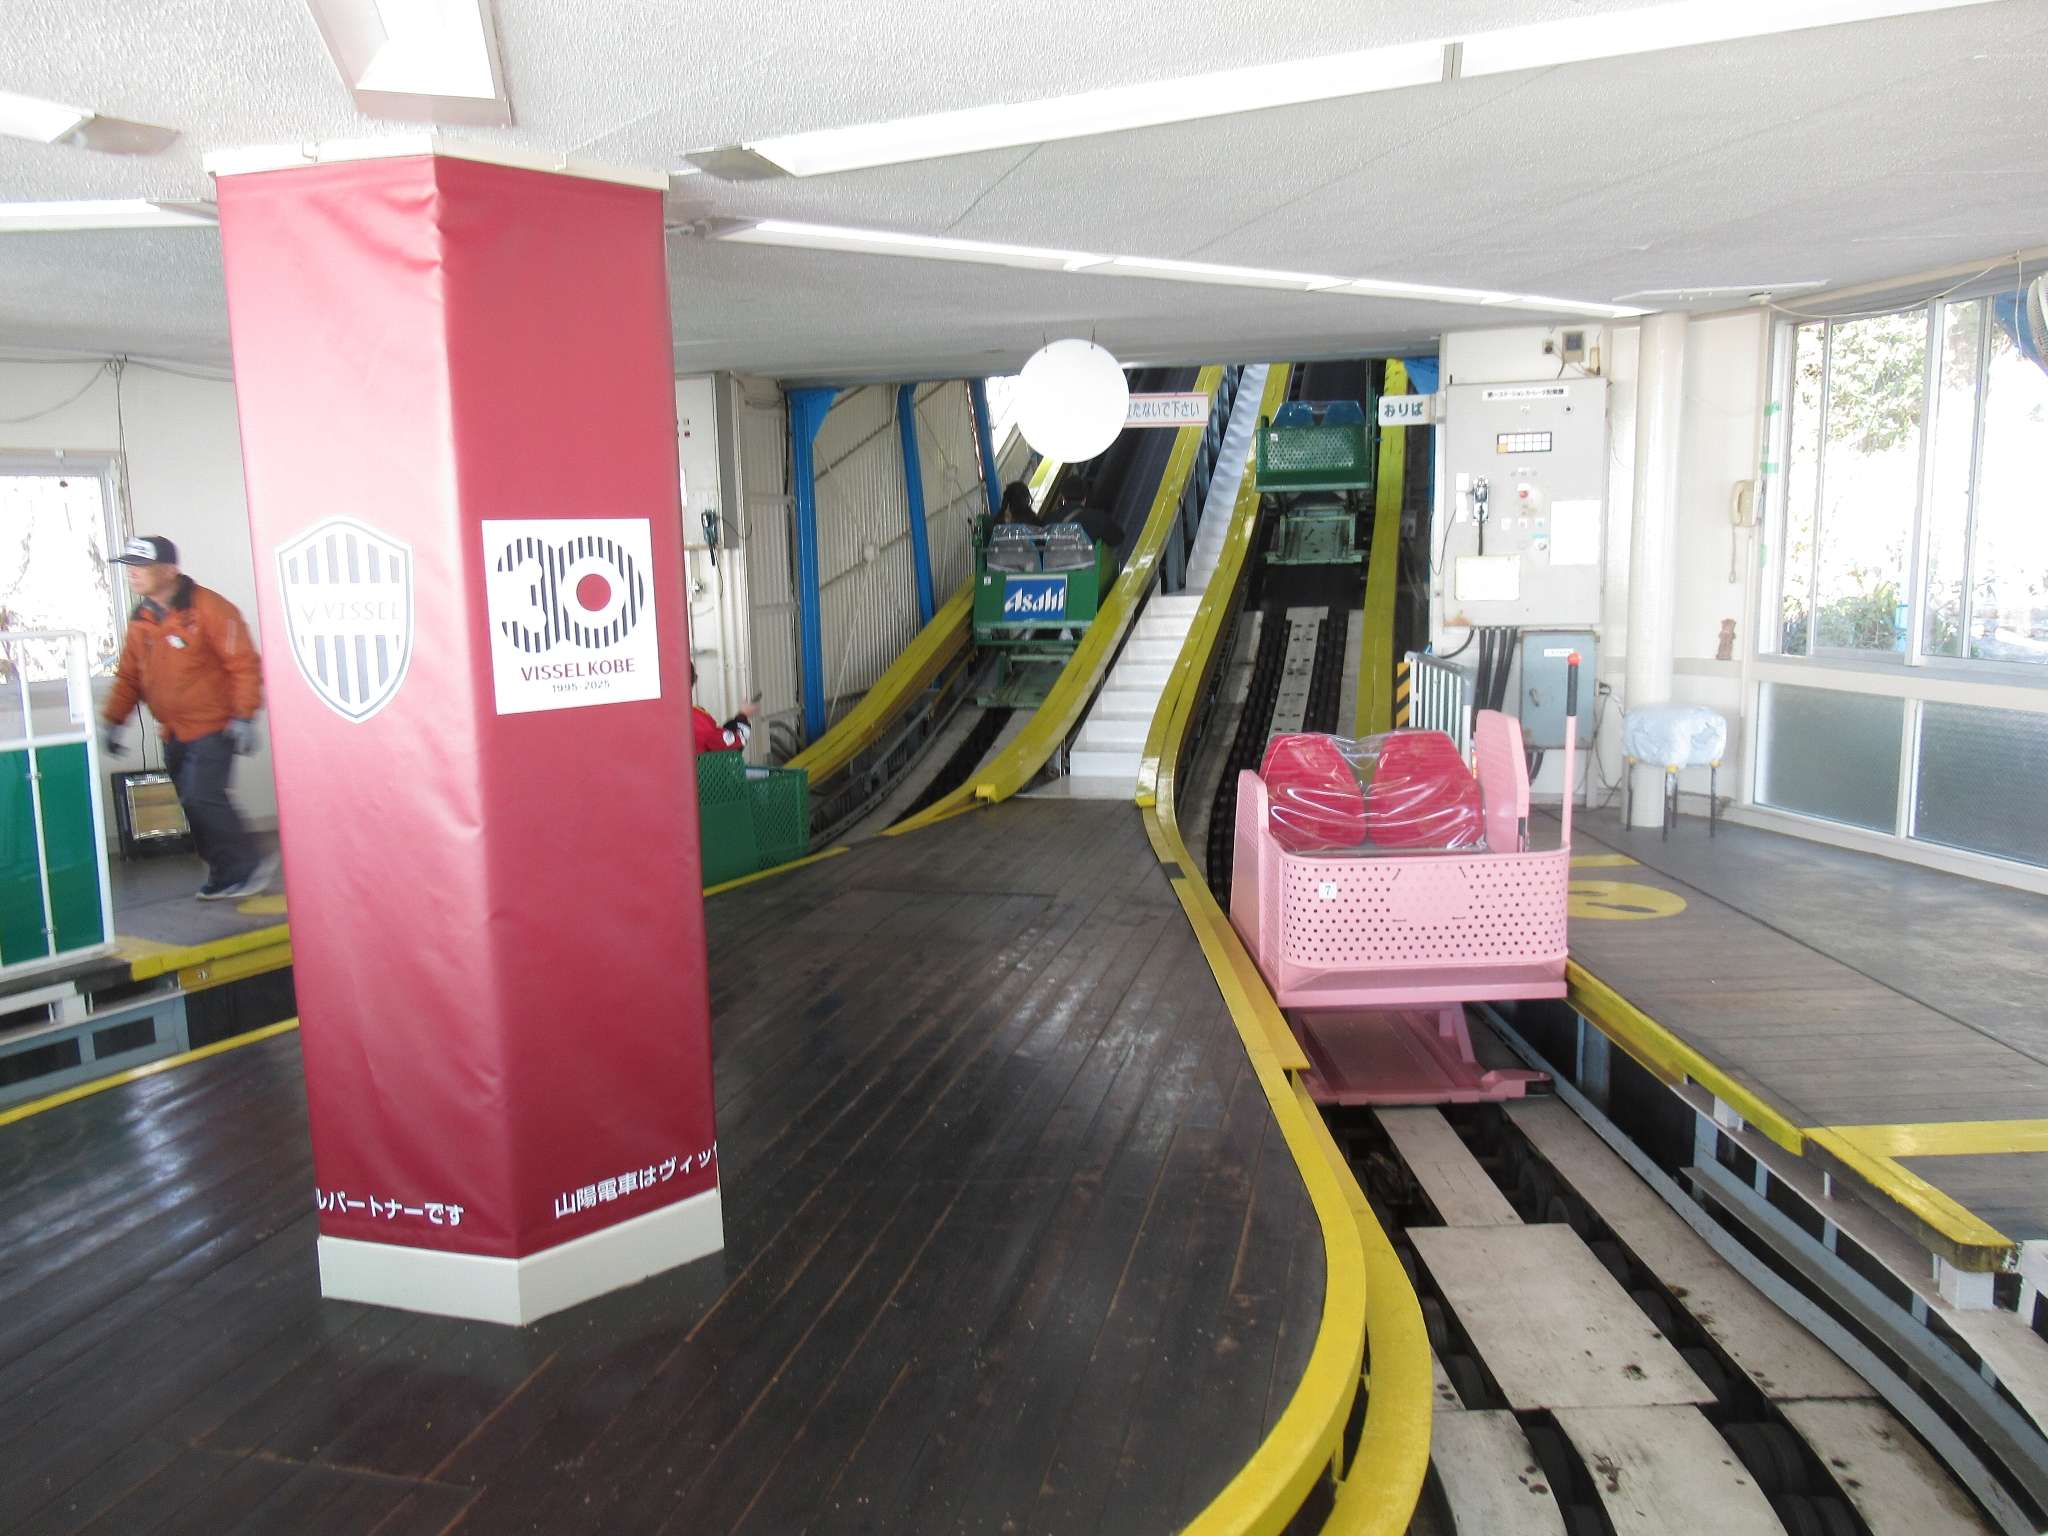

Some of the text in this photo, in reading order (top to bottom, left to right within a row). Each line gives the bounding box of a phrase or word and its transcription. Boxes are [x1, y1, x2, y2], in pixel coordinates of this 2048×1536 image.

[1127, 400, 1200, 417] たないで下さい
[1384, 401, 1424, 417] おりば
[1004, 586, 1065, 613] Asahi
[324, 600, 401, 621] VISSEL
[521, 657, 636, 682] VISSEL KOBE
